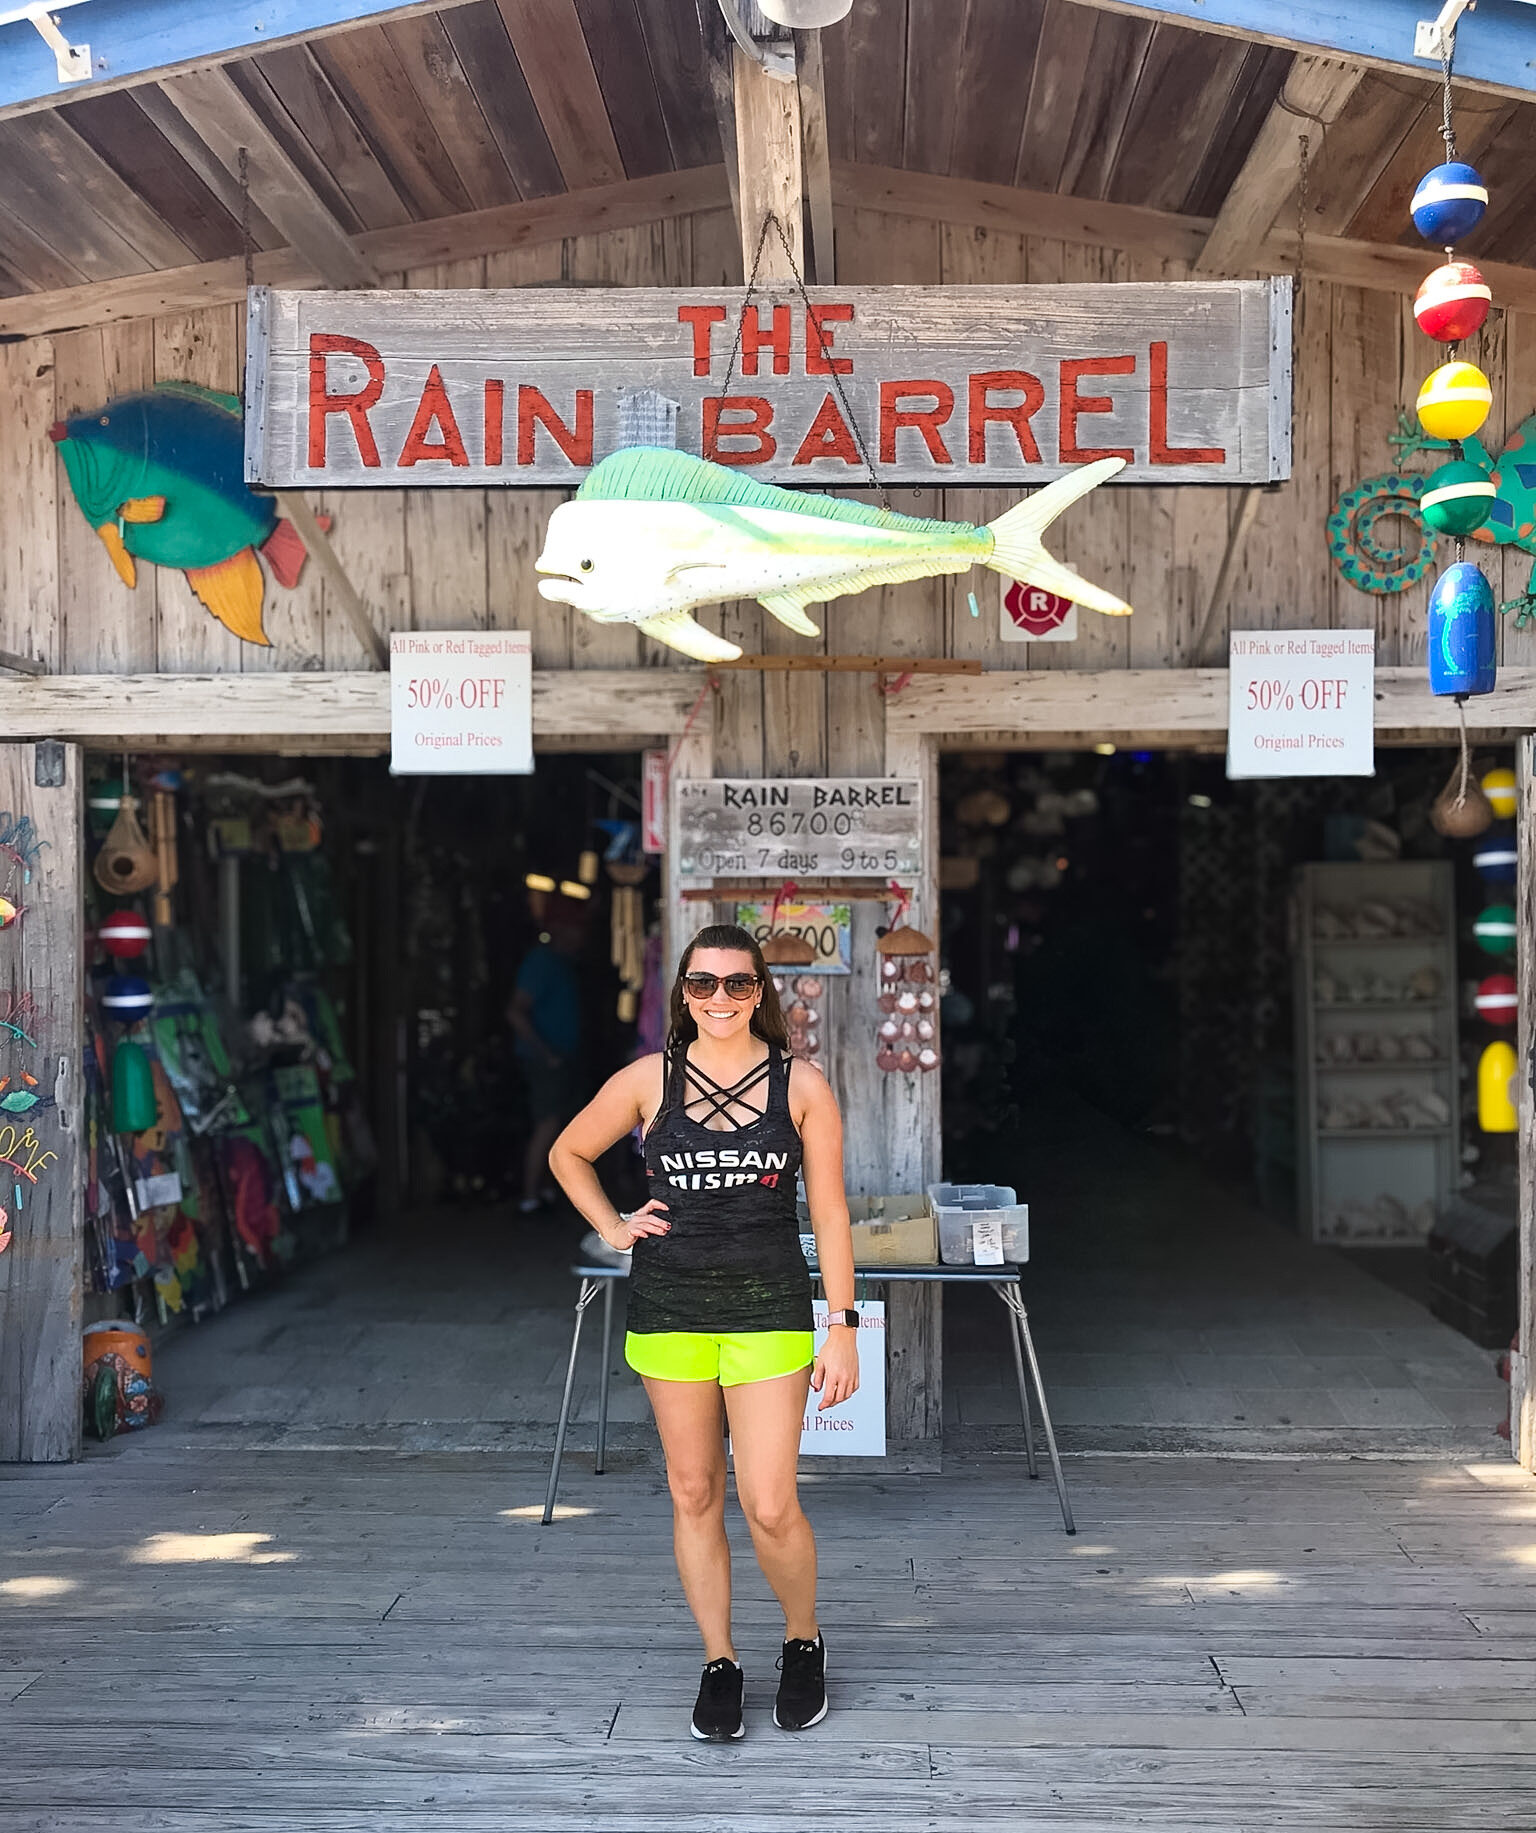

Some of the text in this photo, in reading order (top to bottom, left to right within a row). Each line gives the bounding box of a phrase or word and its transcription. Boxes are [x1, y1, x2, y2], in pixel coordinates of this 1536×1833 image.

[677, 304, 854, 377] THE
[307, 332, 1226, 468] RAIN BARREL
[1030, 592, 1048, 611] R
[391, 639, 531, 658] All Pink or Red Tagged Items
[1232, 640, 1375, 658] All Pink or Red Tagged Items
[408, 678, 506, 709] 50% OFF
[1247, 679, 1348, 711] 50% OFF
[415, 731, 503, 749] Original Prices
[1254, 734, 1345, 751] Original Prices
[724, 783, 790, 809] RAIN
[813, 785, 911, 808] BARREL
[747, 812, 852, 836] 86700
[700, 849, 898, 874] Open 7 days 9 to 5
[755, 925, 836, 957] 800
[660, 1150, 788, 1172] NISSAN
[858, 1314, 886, 1329] tems
[815, 1415, 854, 1431] Prices
